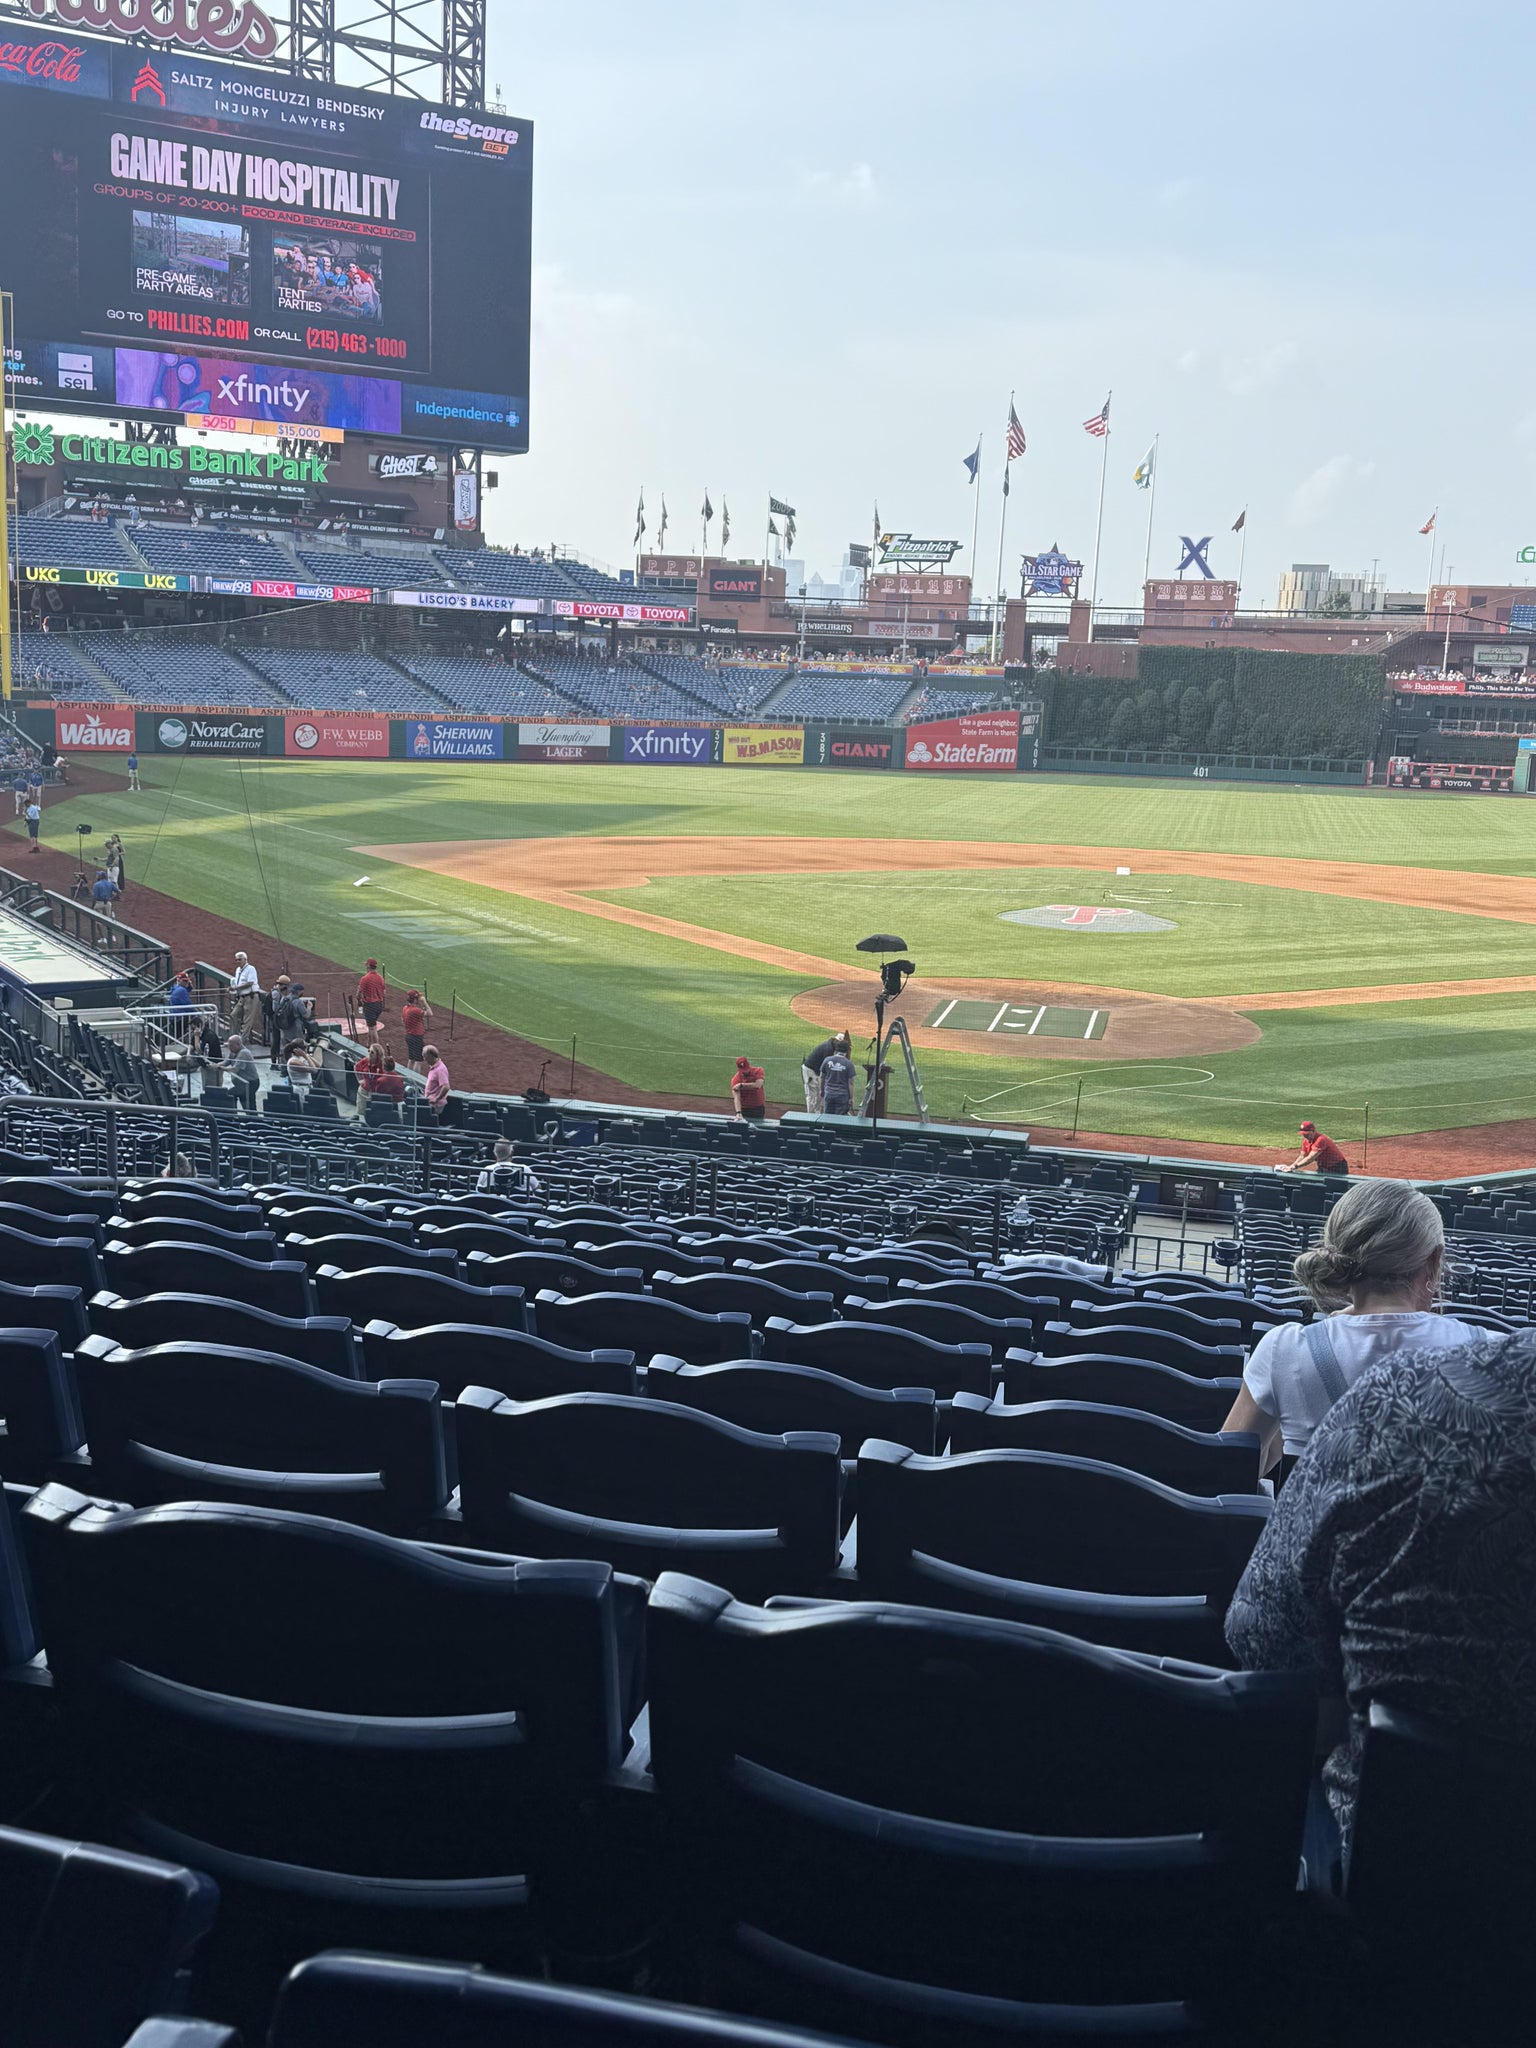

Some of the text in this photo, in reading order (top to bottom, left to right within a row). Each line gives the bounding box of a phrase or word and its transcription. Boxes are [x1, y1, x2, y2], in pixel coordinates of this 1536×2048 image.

[171, 71, 385, 121] SALTZ MONGELUZZI BENDESKY
[215, 100, 345, 132] INJURY LAWYERS
[420, 112, 519, 145] theScore
[484, 142, 507, 153] BET
[110, 132, 400, 220] GAME DAY HOSPITALITY
[93, 183, 238, 214] GROUPS OF 20-200+
[243, 206, 414, 241] FOOD AND BEVERAGE INCLUDED
[136, 267, 197, 286] PRE-GAME
[136, 278, 214, 299] PARTY AREAS
[278, 286, 306, 300] TENT
[278, 297, 322, 313] PARTIES
[106, 309, 125, 320] GO
[127, 311, 144, 322] TO
[148, 308, 249, 341] PHILLIES.COM
[253, 327, 271, 339] OR
[272, 329, 302, 342] CALL
[306, 327, 339, 353] (215)
[3, 346, 22, 360] ing
[3, 360, 26, 371] ter
[5, 373, 43, 386] omes.
[217, 373, 310, 412] xfinity
[415, 400, 503, 423] Independence
[278, 425, 321, 439] $15,000
[61, 433, 328, 484] Citizens Bank Park
[380, 454, 427, 479] GHOST
[240, 481, 278, 491] ENERGY
[280, 485, 306, 493] DECK
[885, 535, 954, 552] Fitzpatrick
[1174, 536, 1217, 579] X
[25, 566, 176, 590] UKG UKG UKG
[1021, 565, 1082, 577] ALL STAR GAME
[256, 583, 293, 596] NECA
[337, 588, 372, 602] NECA
[713, 580, 757, 592] GIANT
[419, 593, 514, 610] LISCIO'S BAKERY
[577, 603, 686, 620] TOYOTA TOYOTA
[710, 625, 736, 634] Fanatics
[1414, 682, 1458, 692] Budweiser
[56, 702, 116, 711] ASPLUNDH
[126, 704, 184, 713] ASPLUNDH
[194, 706, 250, 715] ASPLUNDH
[260, 708, 313, 717] ASPLUNDH
[323, 710, 375, 719] ASPLUNDH
[384, 712, 434, 721] ASPLUNDH
[443, 714, 491, 722] ASPLUNDH
[499, 716, 546, 724] ASPLUNDH
[554, 718, 599, 726] ASPLUNDH
[189, 721, 265, 739] NovaCare
[433, 724, 493, 740] SHERWIN
[977, 720, 991, 728] good
[61, 723, 131, 746] Wawa
[323, 729, 383, 741] F.W. WEBB
[535, 726, 595, 745] Yuengling
[190, 740, 262, 749] REHABILITATION
[336, 740, 369, 749] COMPANY
[630, 729, 706, 758] xfinity
[831, 742, 892, 758] GIANT
[546, 747, 583, 758] LAGER
[1193, 767, 1209, 778] 401
[1444, 780, 1472, 788] TOYOTA
